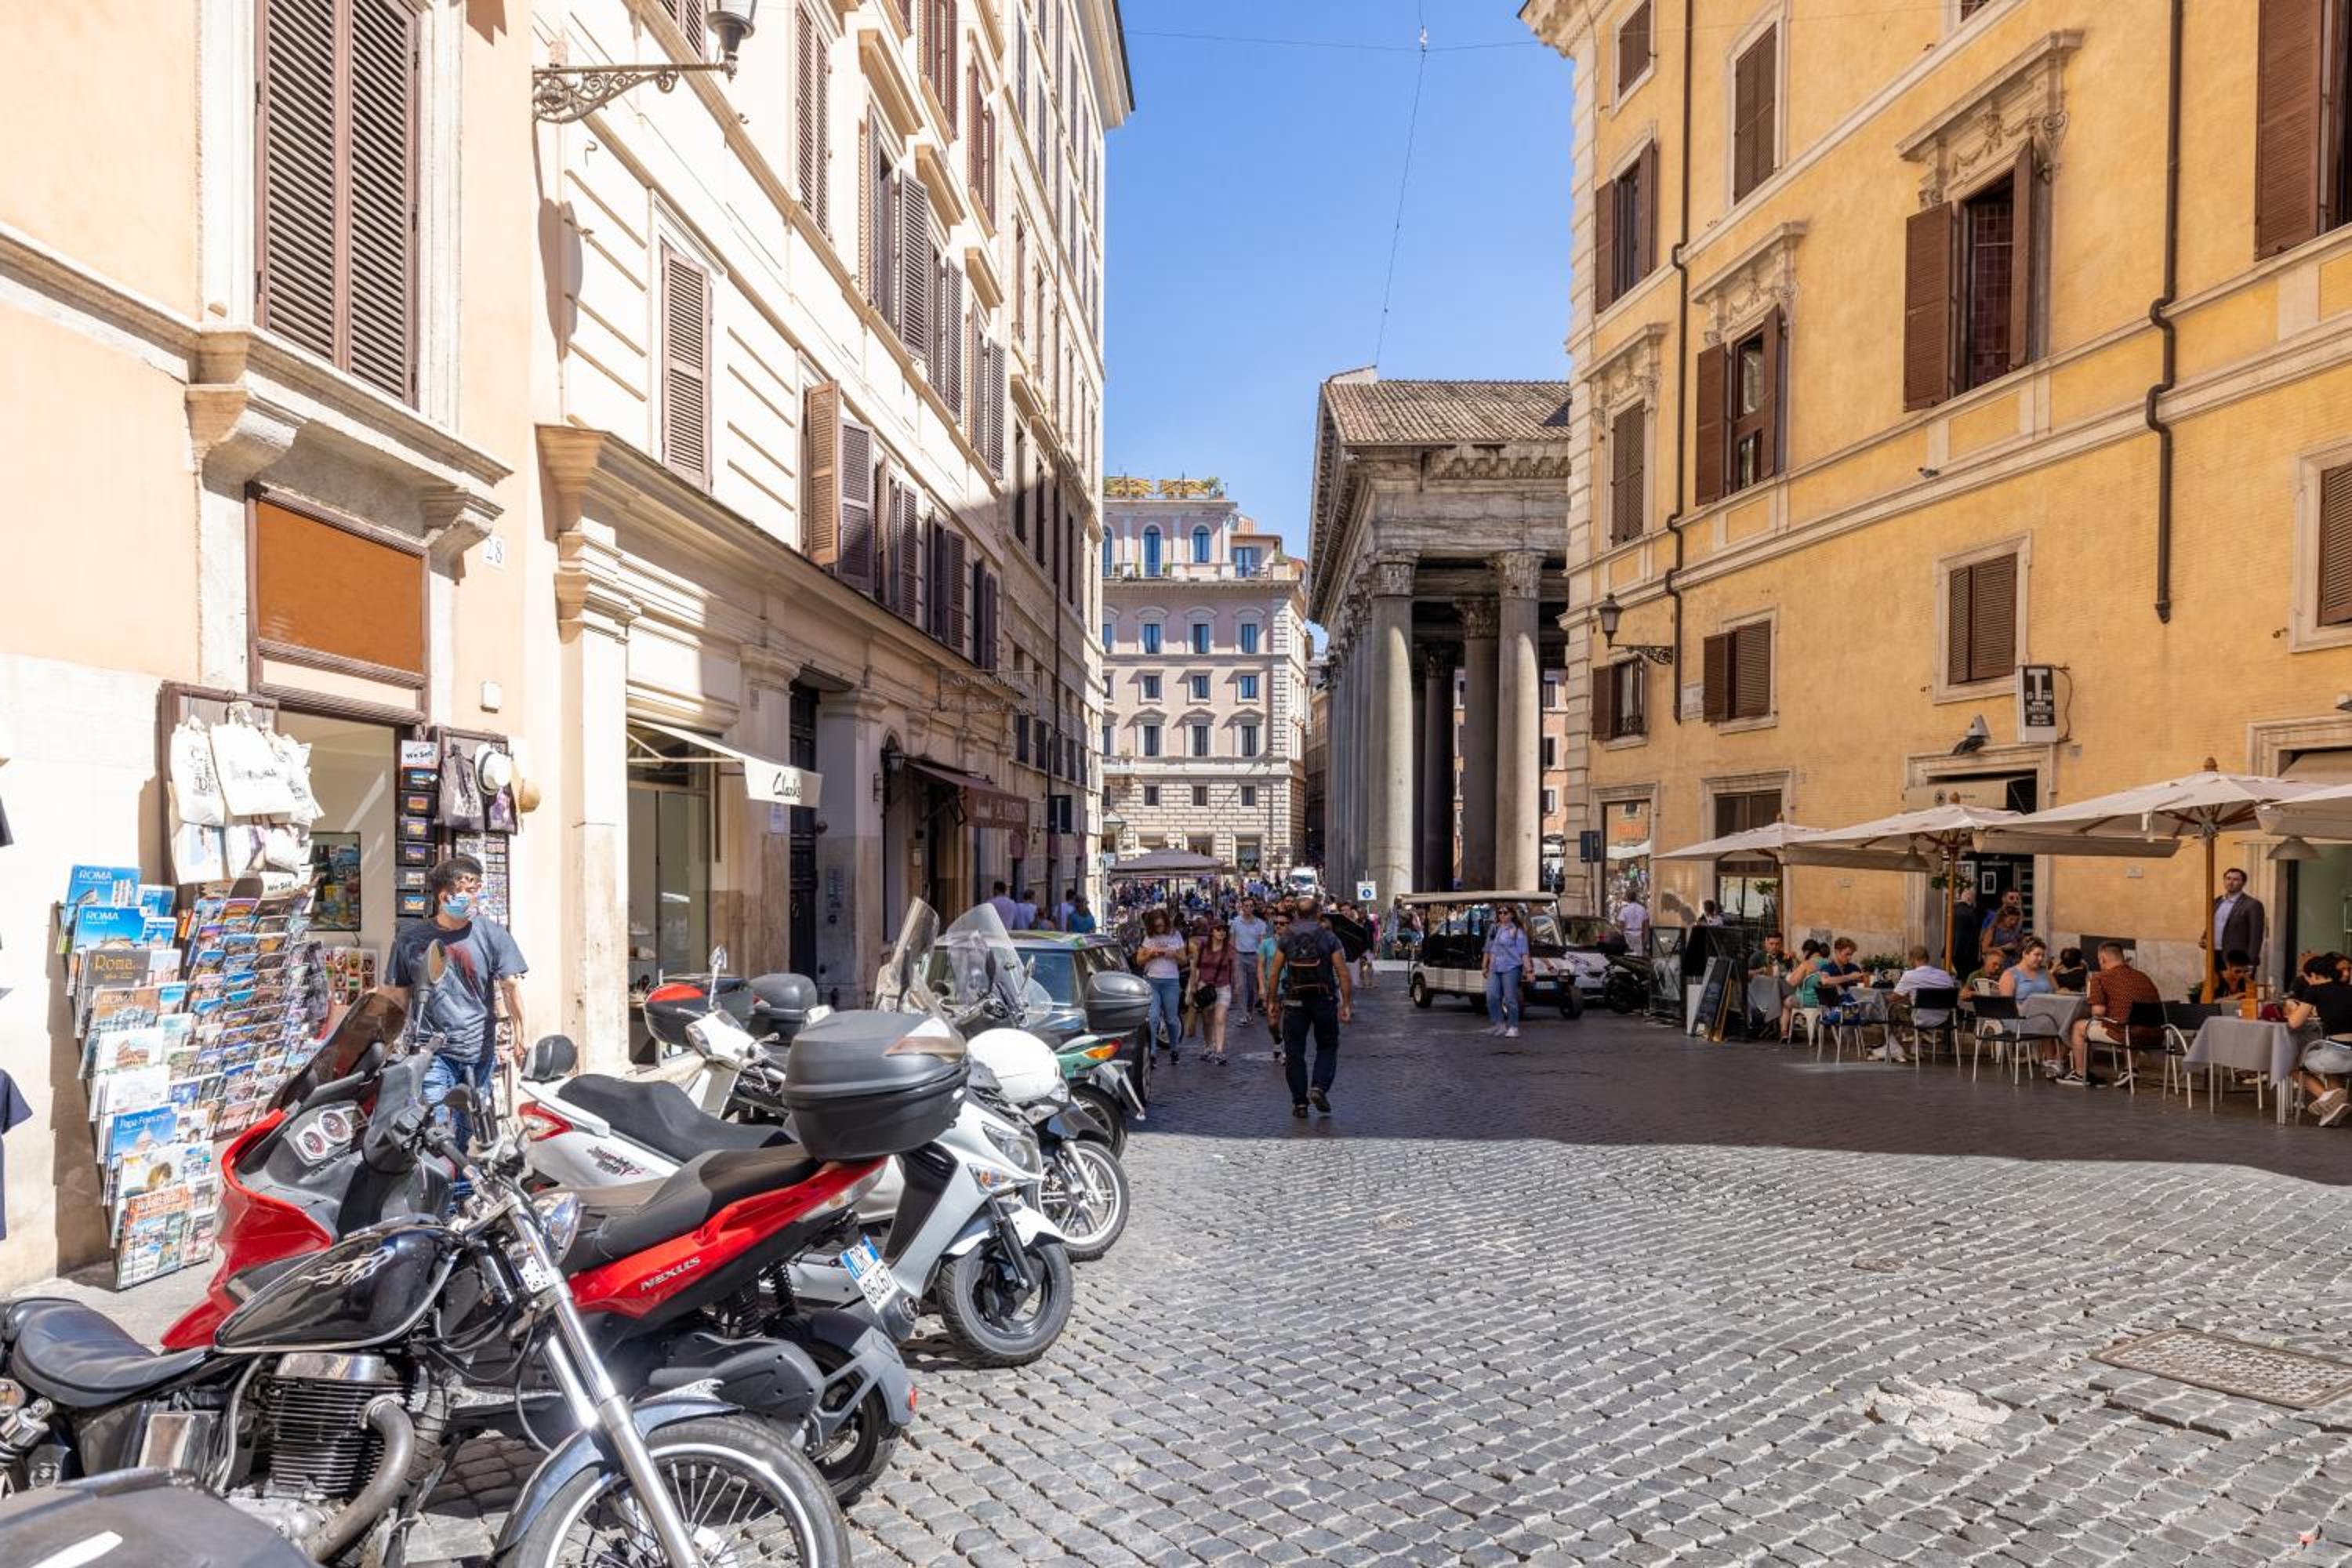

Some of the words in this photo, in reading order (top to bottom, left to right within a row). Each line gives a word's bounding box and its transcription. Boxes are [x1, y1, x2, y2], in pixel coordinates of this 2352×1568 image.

[79, 869, 113, 880] ROMA
[85, 910, 119, 920] ROMA
[640, 1255, 702, 1292] NEXUS
